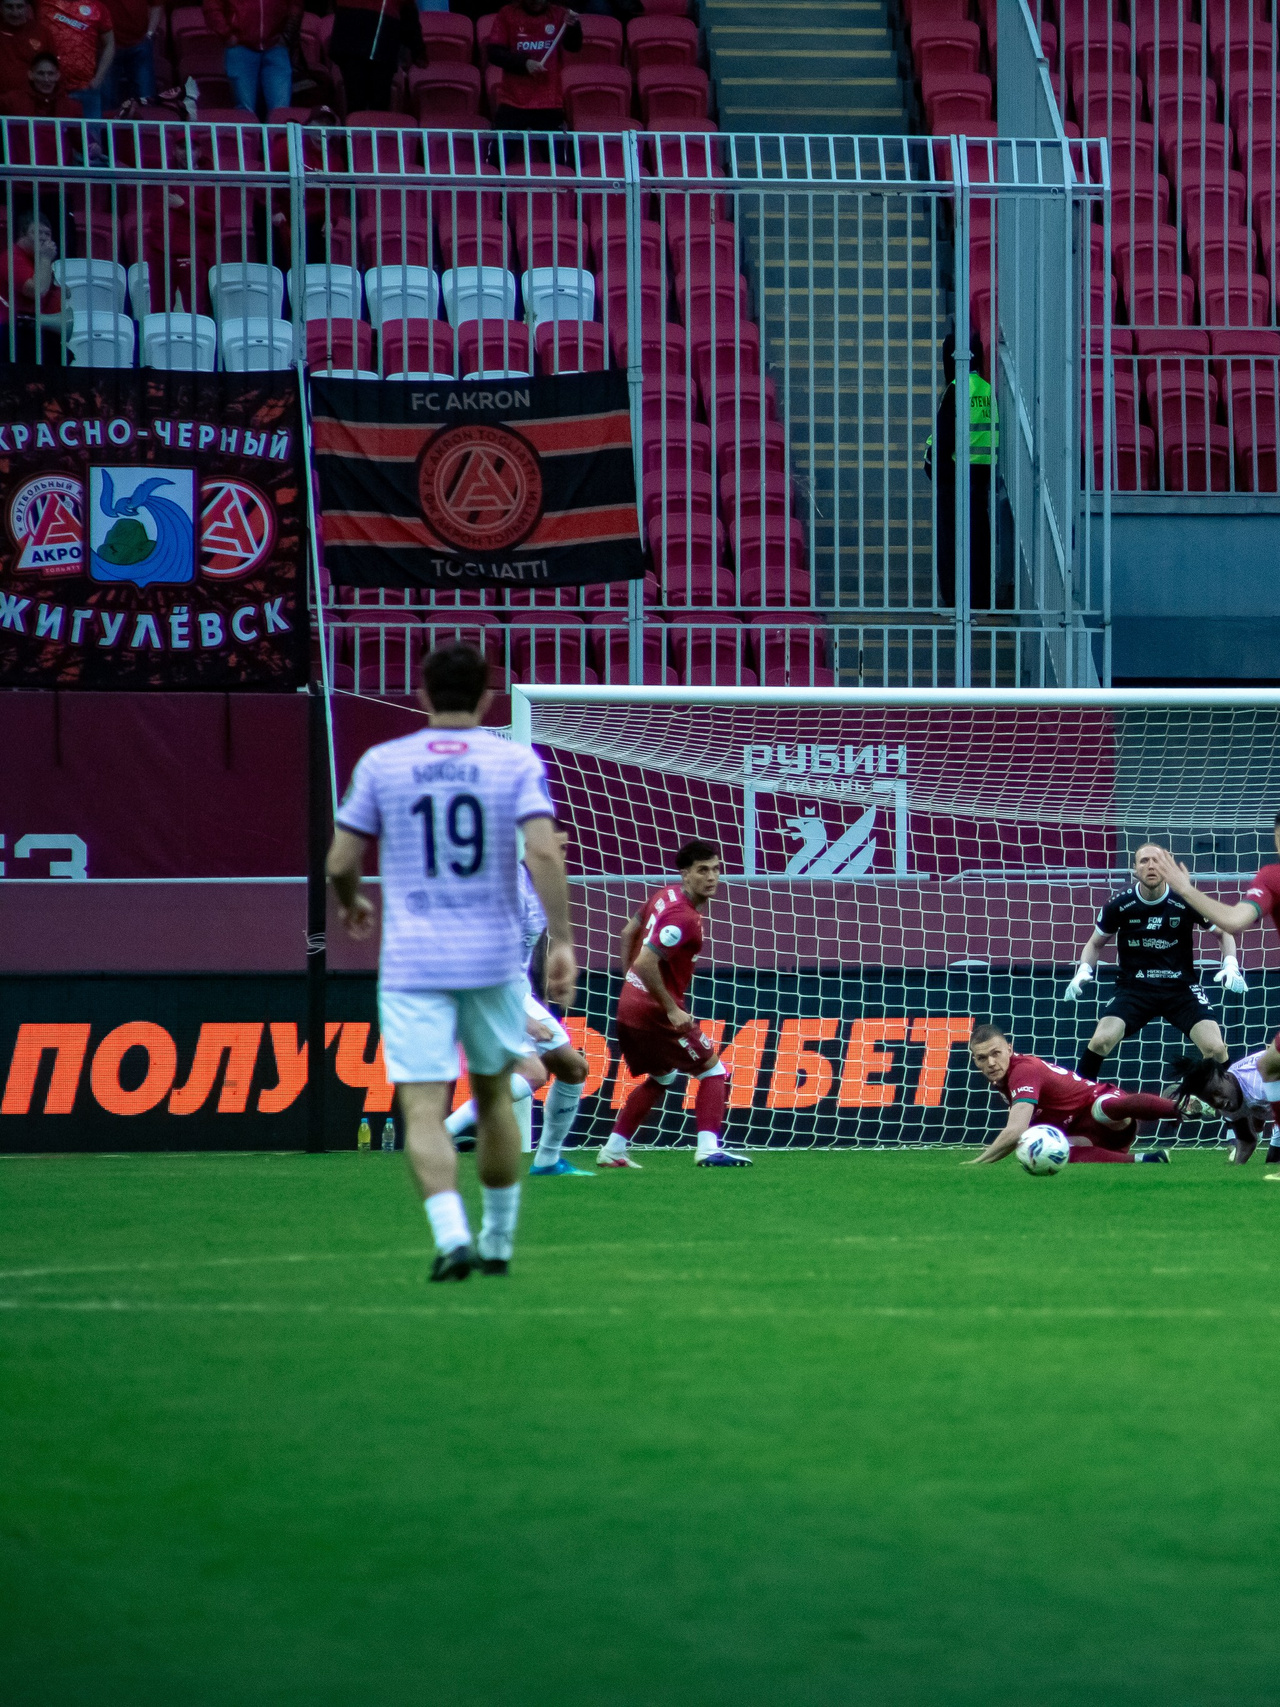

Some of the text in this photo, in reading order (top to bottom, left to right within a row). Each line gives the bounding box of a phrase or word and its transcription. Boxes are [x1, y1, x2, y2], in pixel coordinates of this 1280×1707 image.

[517, 41, 554, 51] FONBE
[411, 389, 531, 411] FC AKRON
[0, 591, 290, 649] ЖИГУЛЁВСК
[743, 744, 908, 774] РУБИН
[412, 793, 485, 879] 19
[1, 1020, 474, 1116] ПОЛУЧ
[529, 1016, 977, 1110] ИБЕТ
